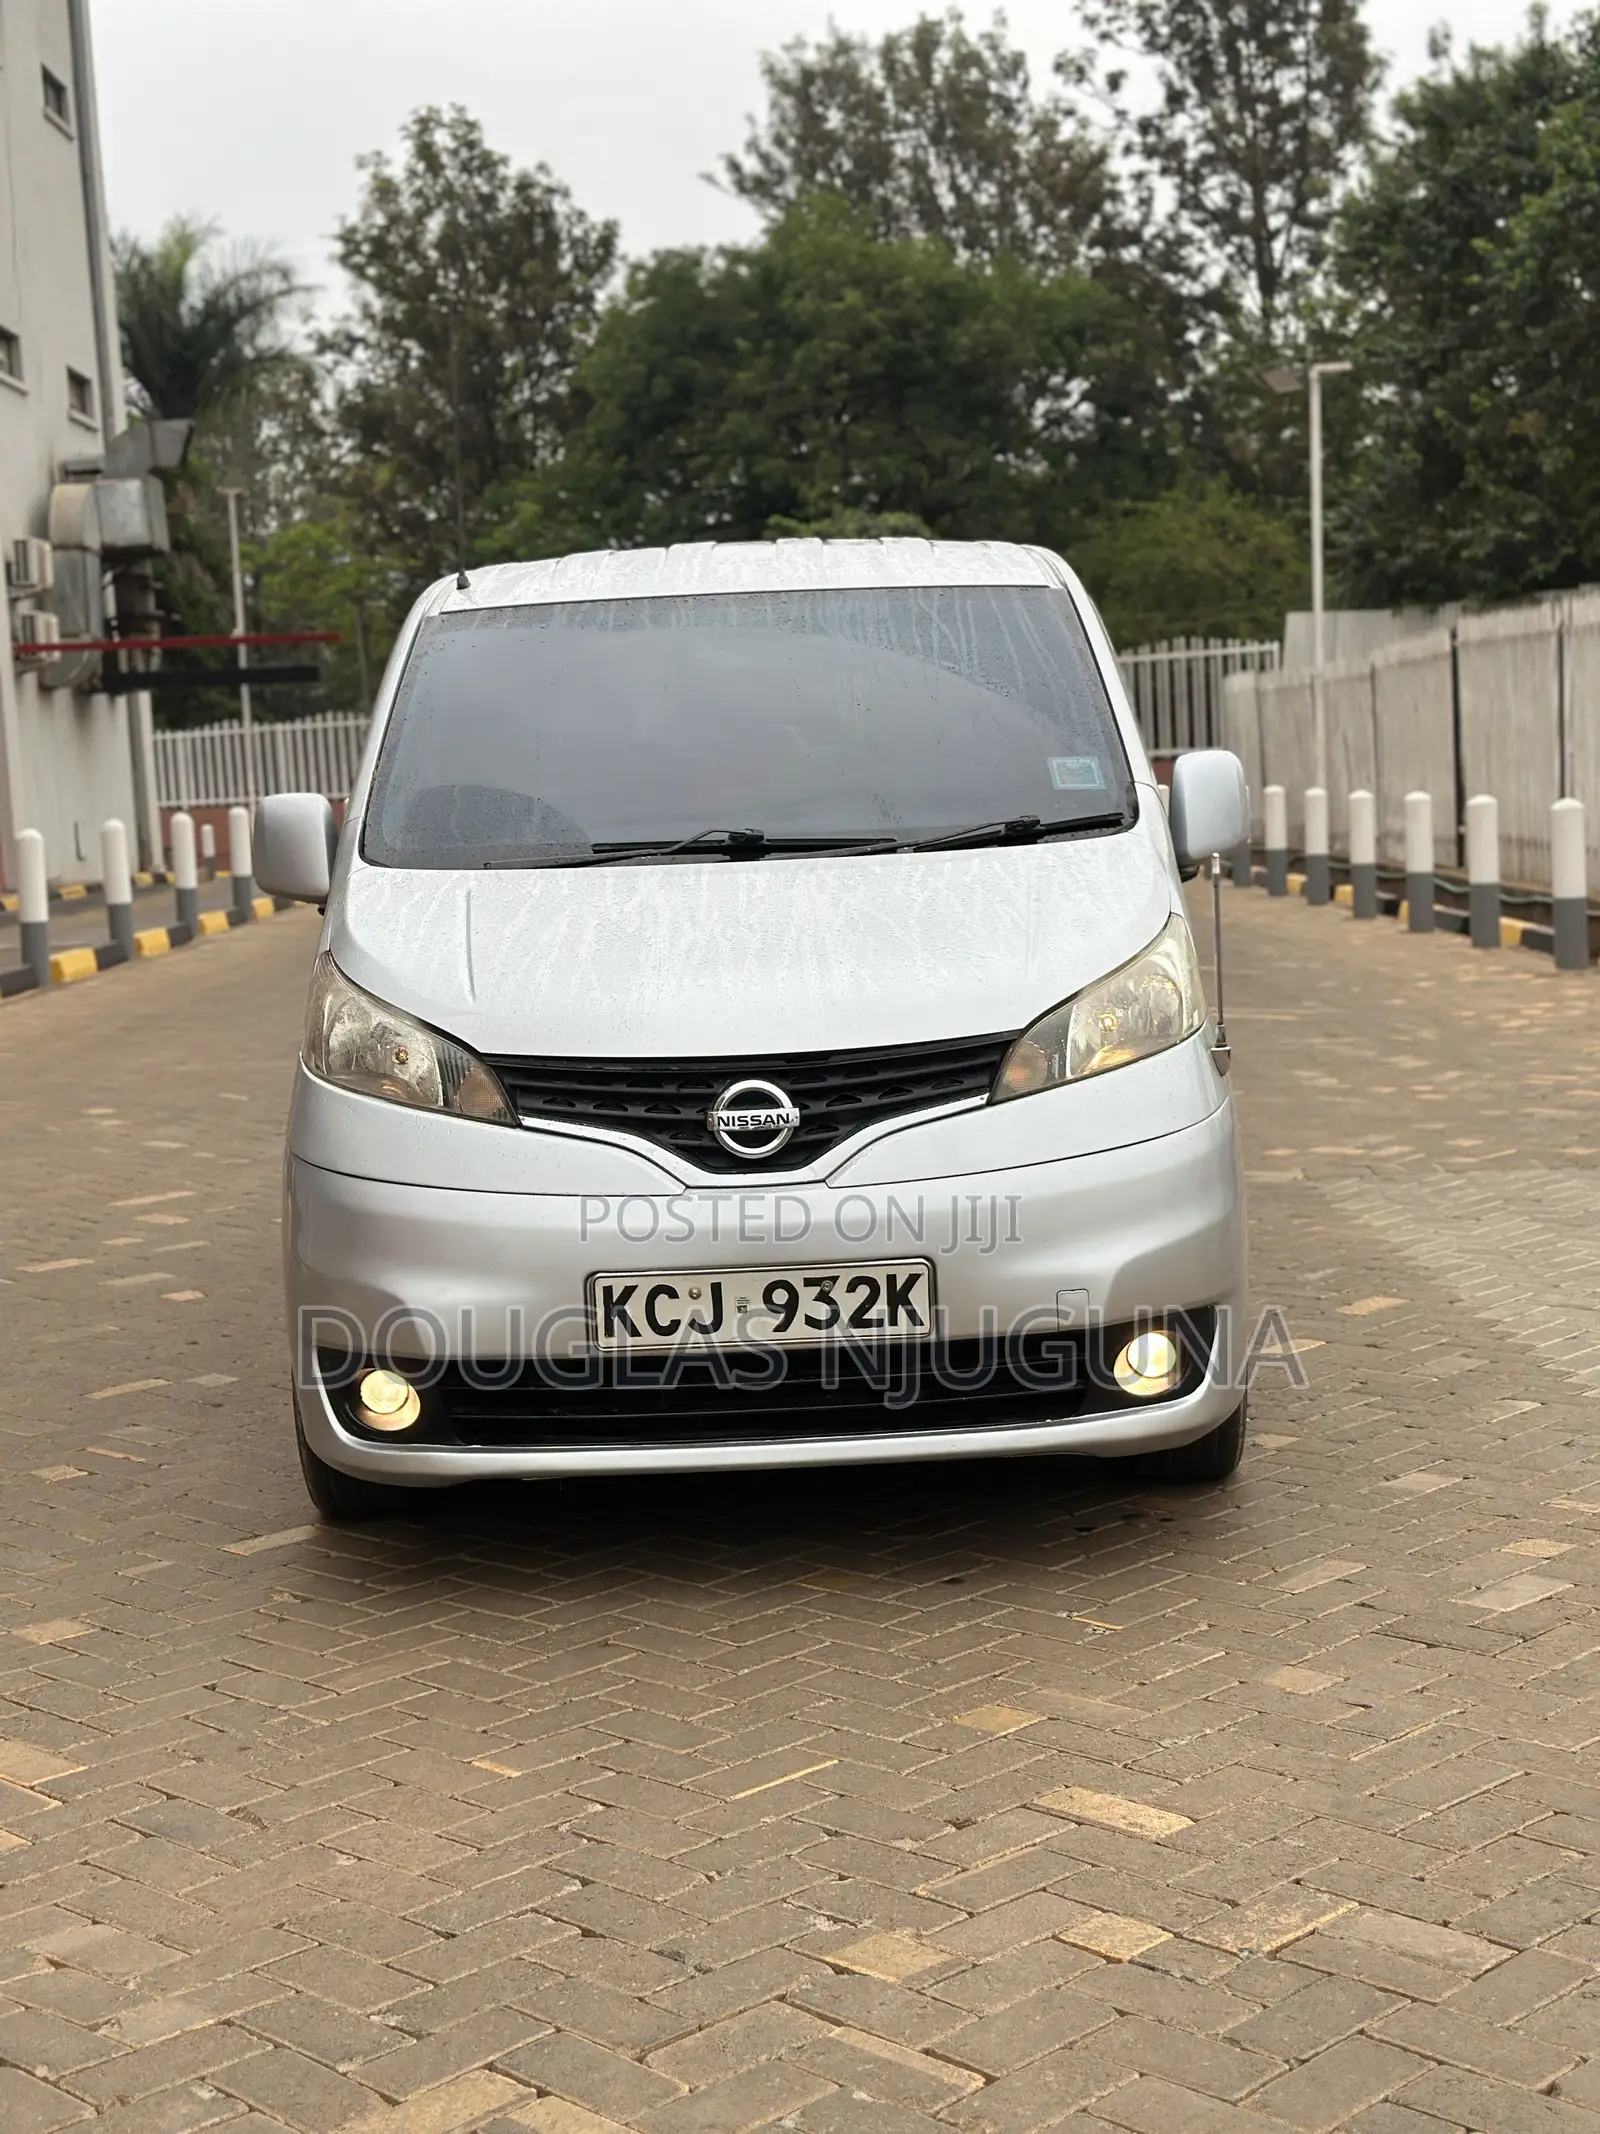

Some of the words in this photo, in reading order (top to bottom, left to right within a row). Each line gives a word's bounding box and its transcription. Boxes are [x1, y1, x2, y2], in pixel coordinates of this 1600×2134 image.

[718, 1113, 790, 1127] NISSAN
[602, 1281, 724, 1338] KCJ
[761, 1272, 925, 1333] 932K
